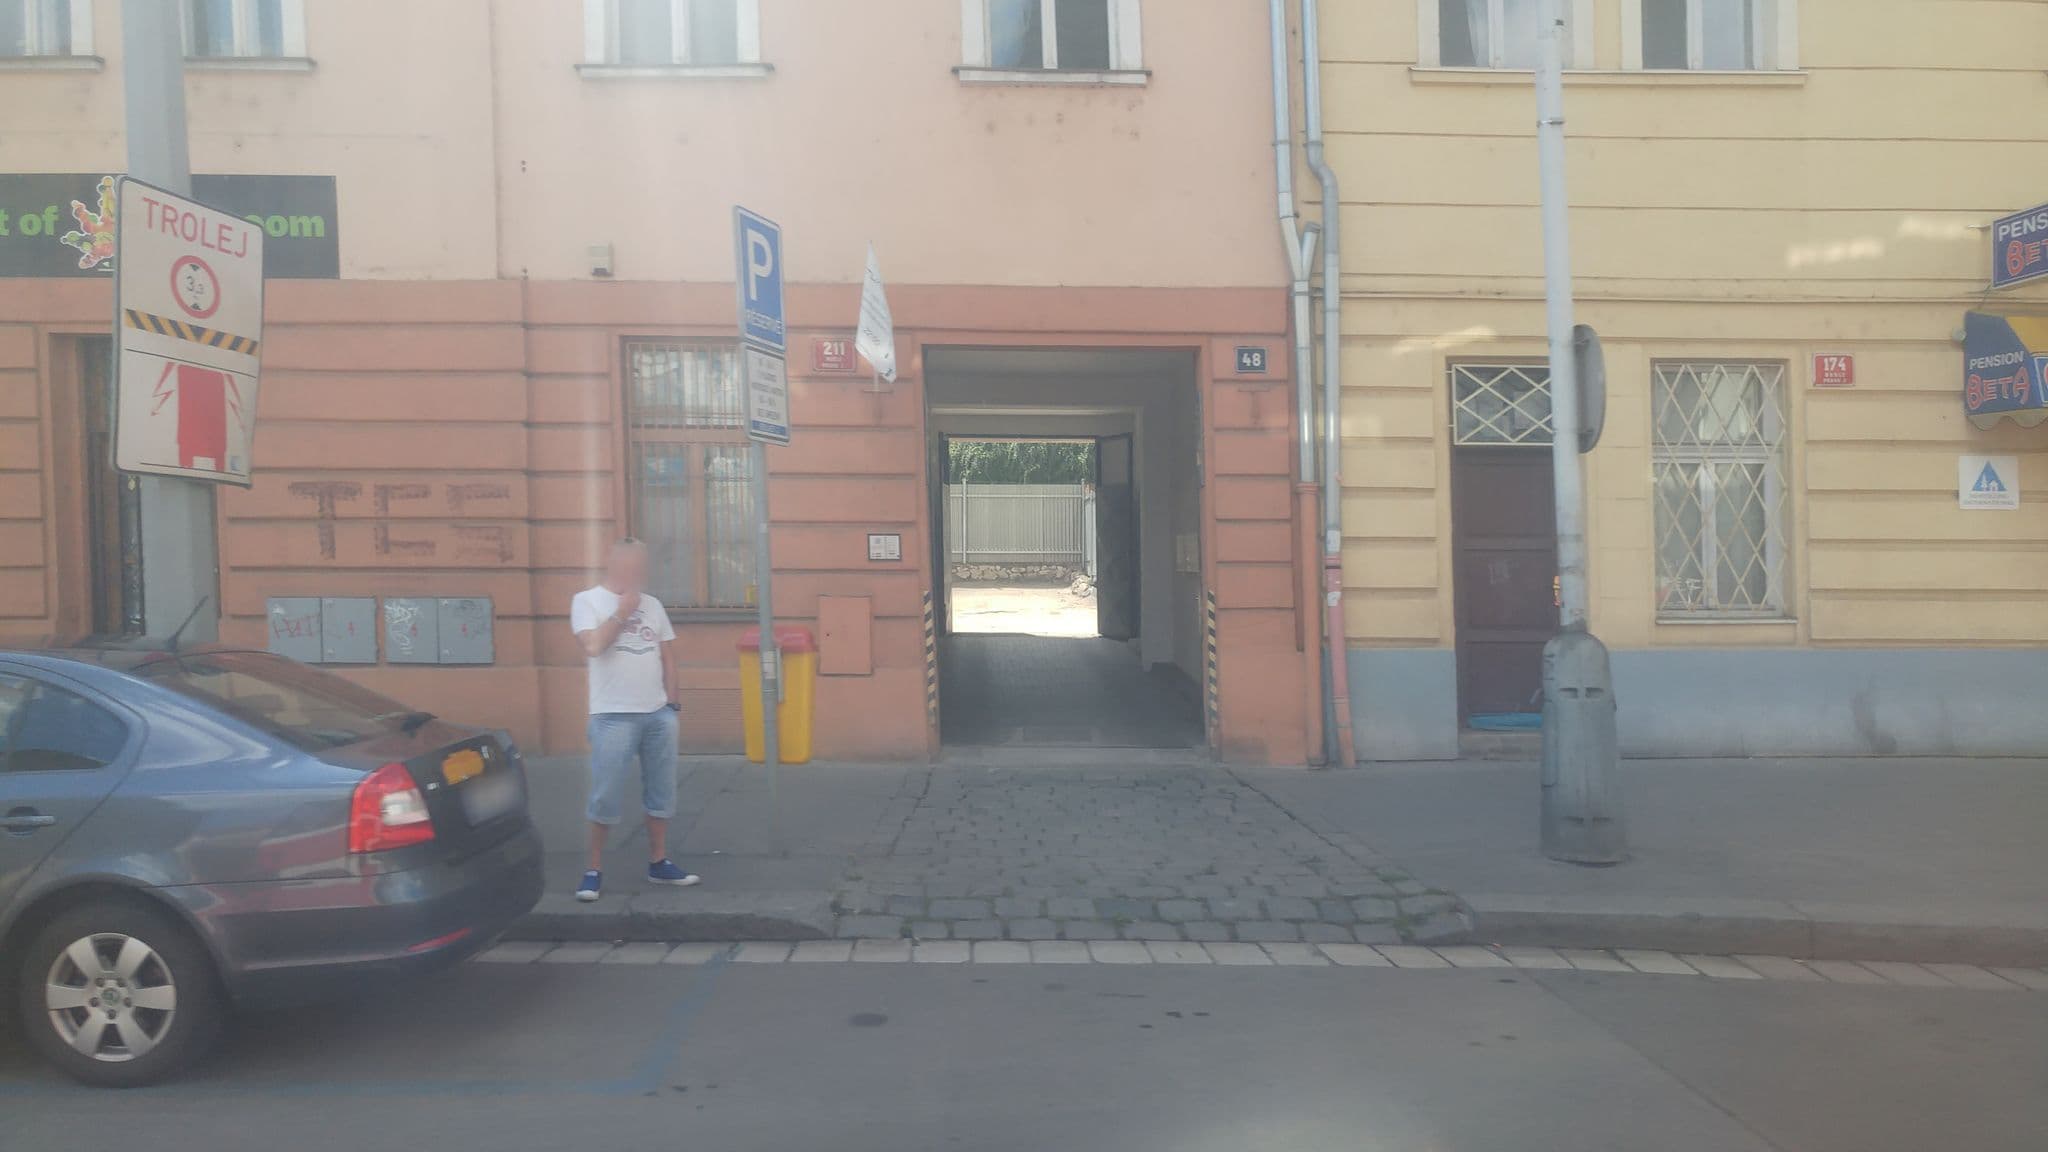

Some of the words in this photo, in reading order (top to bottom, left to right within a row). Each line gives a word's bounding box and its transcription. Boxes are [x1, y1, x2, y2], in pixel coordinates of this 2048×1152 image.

[20, 205, 59, 236] of
[142, 196, 248, 258] TROLEJ
[746, 227, 773, 301] P
[823, 341, 846, 356] 211
[1242, 352, 1261, 367] 48
[1968, 350, 2025, 370] PENSION
[1823, 357, 1847, 371] 174
[1966, 366, 2031, 411] BETA
